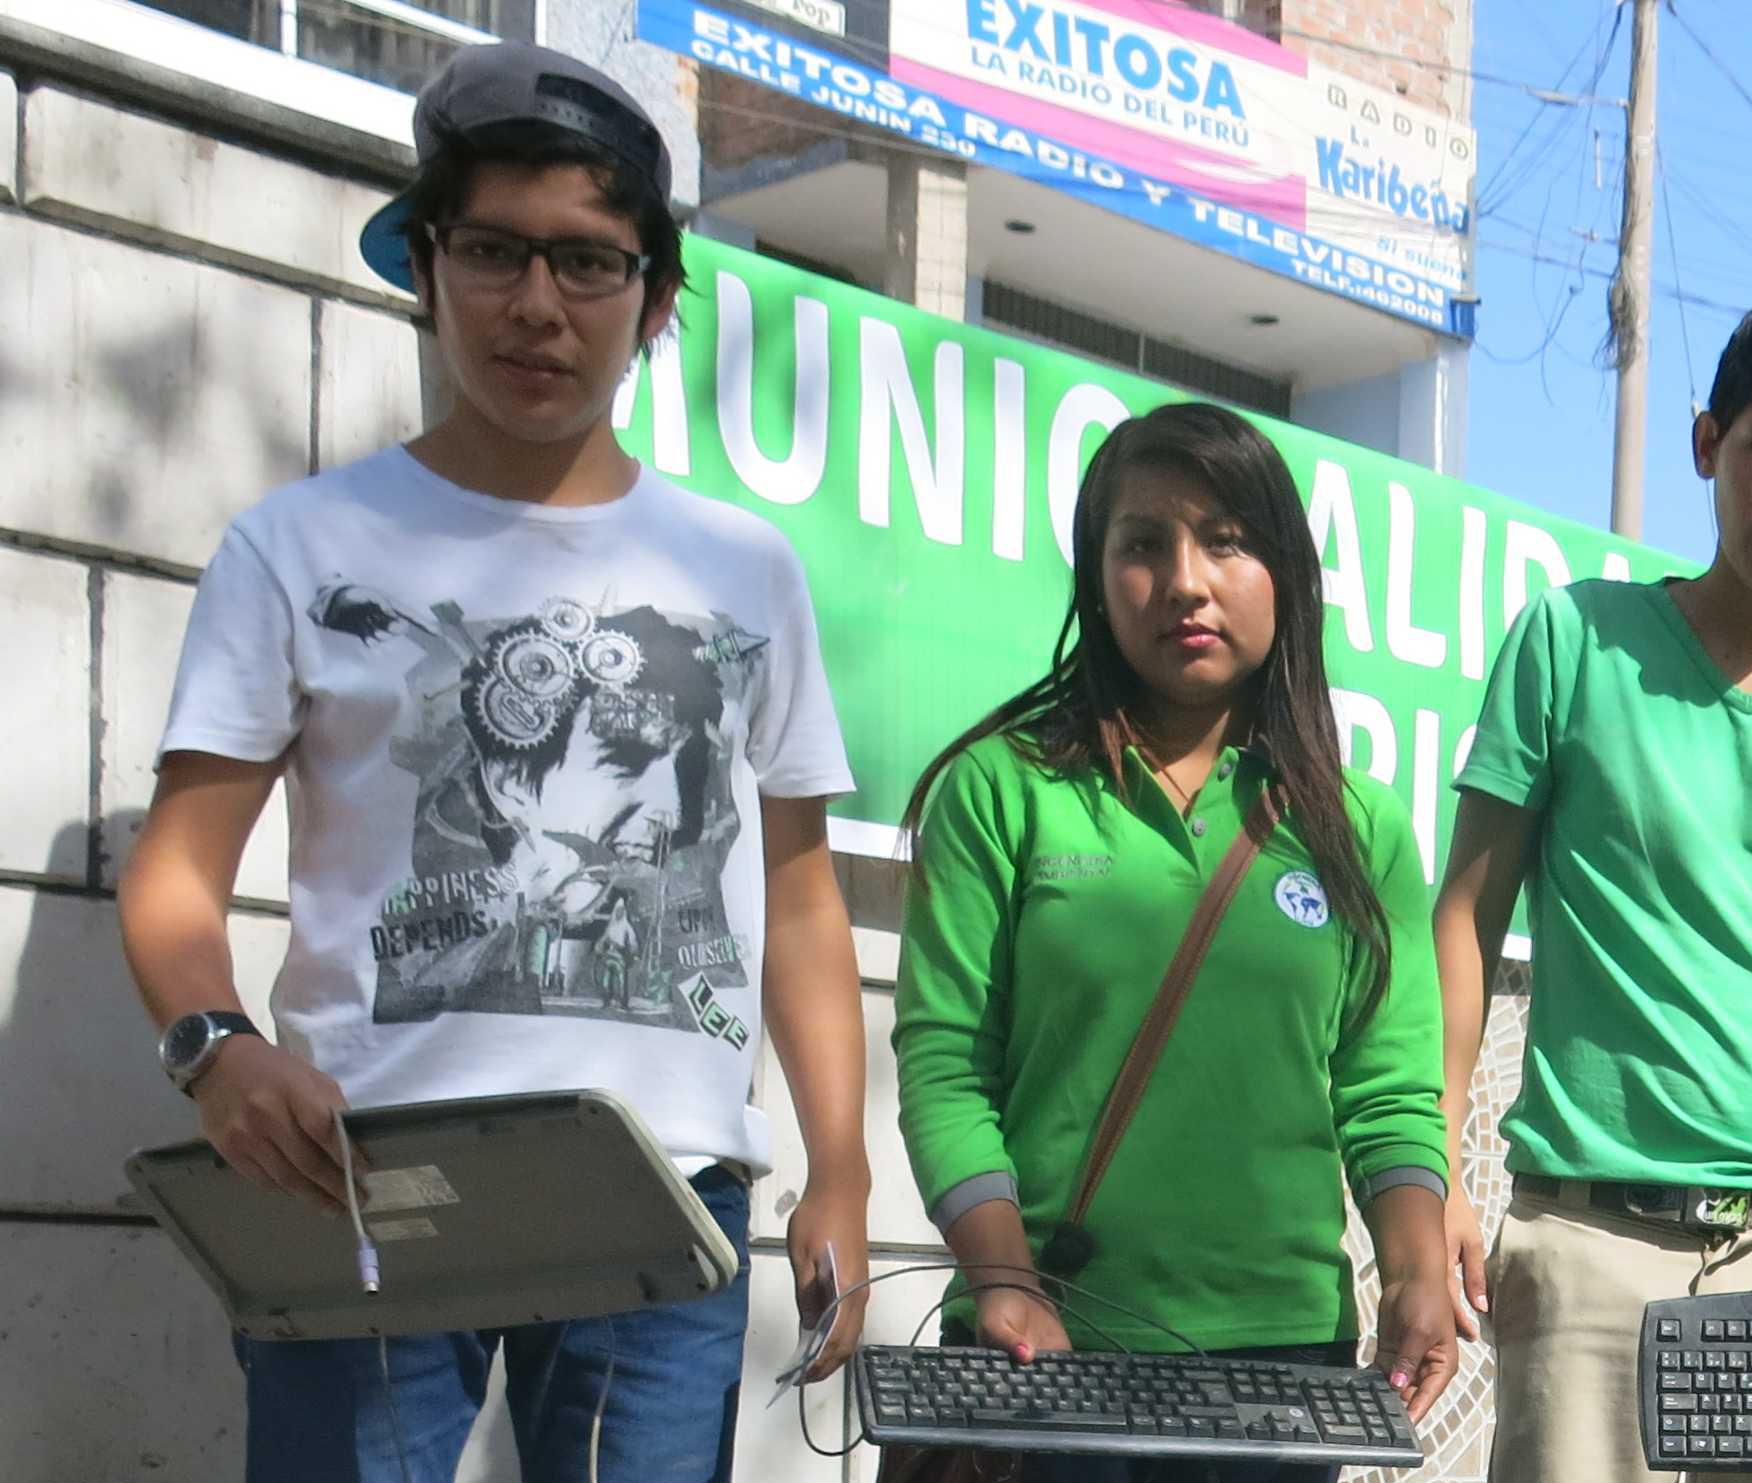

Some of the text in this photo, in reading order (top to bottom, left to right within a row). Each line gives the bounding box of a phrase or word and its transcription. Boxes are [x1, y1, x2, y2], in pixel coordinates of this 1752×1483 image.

[690, 39, 800, 94] CALLE
[811, 85, 912, 132] JUNIN
[966, 0, 1247, 121] EXITOSA
[971, 46, 1007, 75] LA
[1018, 60, 1112, 106] RADIO
[1123, 92, 1173, 126] DEL
[692, 9, 1444, 309] EXITOSA RADIO Y TELEVISION
[1326, 83, 1468, 161] RADIO
[1314, 134, 1470, 237] Karibeña
[370, 910, 489, 961] DEPENDS
[688, 974, 750, 1051] LEE
